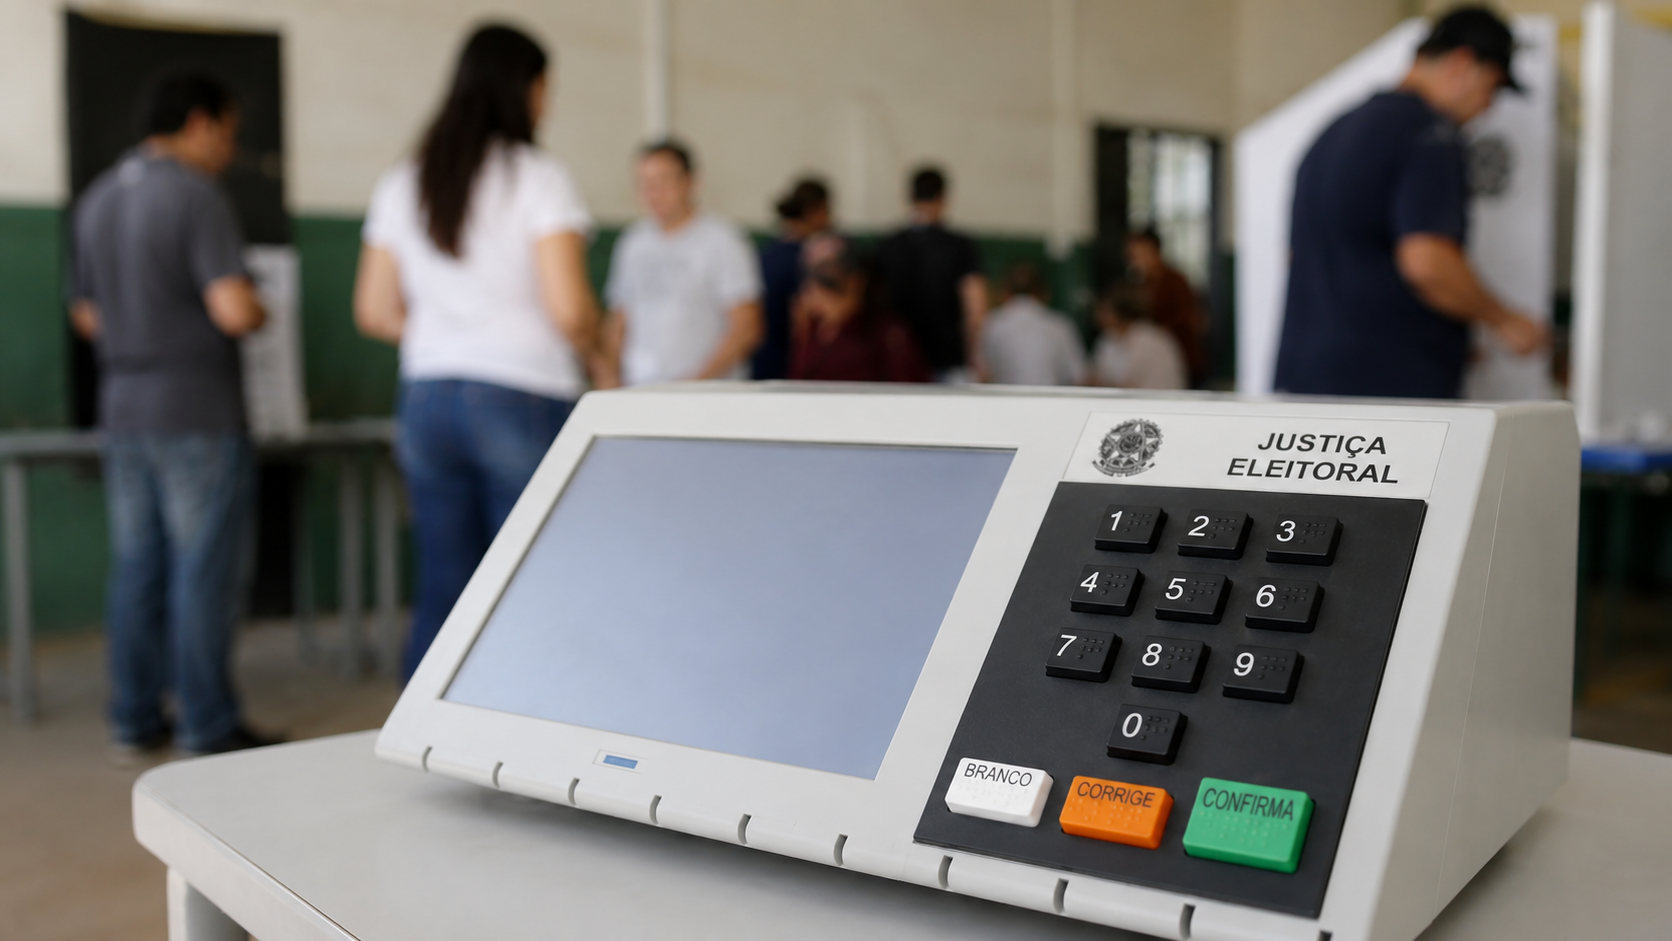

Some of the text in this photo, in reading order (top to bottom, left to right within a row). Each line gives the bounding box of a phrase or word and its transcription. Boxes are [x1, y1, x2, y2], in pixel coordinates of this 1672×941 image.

[1257, 432, 1387, 459] JUSTIÇA
[1227, 458, 1399, 484] ELEITORAL
[1110, 510, 1123, 532] 1
[1187, 515, 1210, 537] 2
[1276, 520, 1296, 542] 3
[1079, 571, 1100, 593] 4
[1165, 577, 1187, 600] 5
[1255, 584, 1277, 608] 6
[1056, 634, 1078, 657] 7
[1141, 642, 1163, 667] 8
[1233, 652, 1255, 677] 9
[1121, 712, 1143, 738] 0
[963, 763, 1033, 787] BRANCO
[1077, 781, 1156, 808] CORRIGE
[1202, 787, 1294, 821] CONFIRMA
